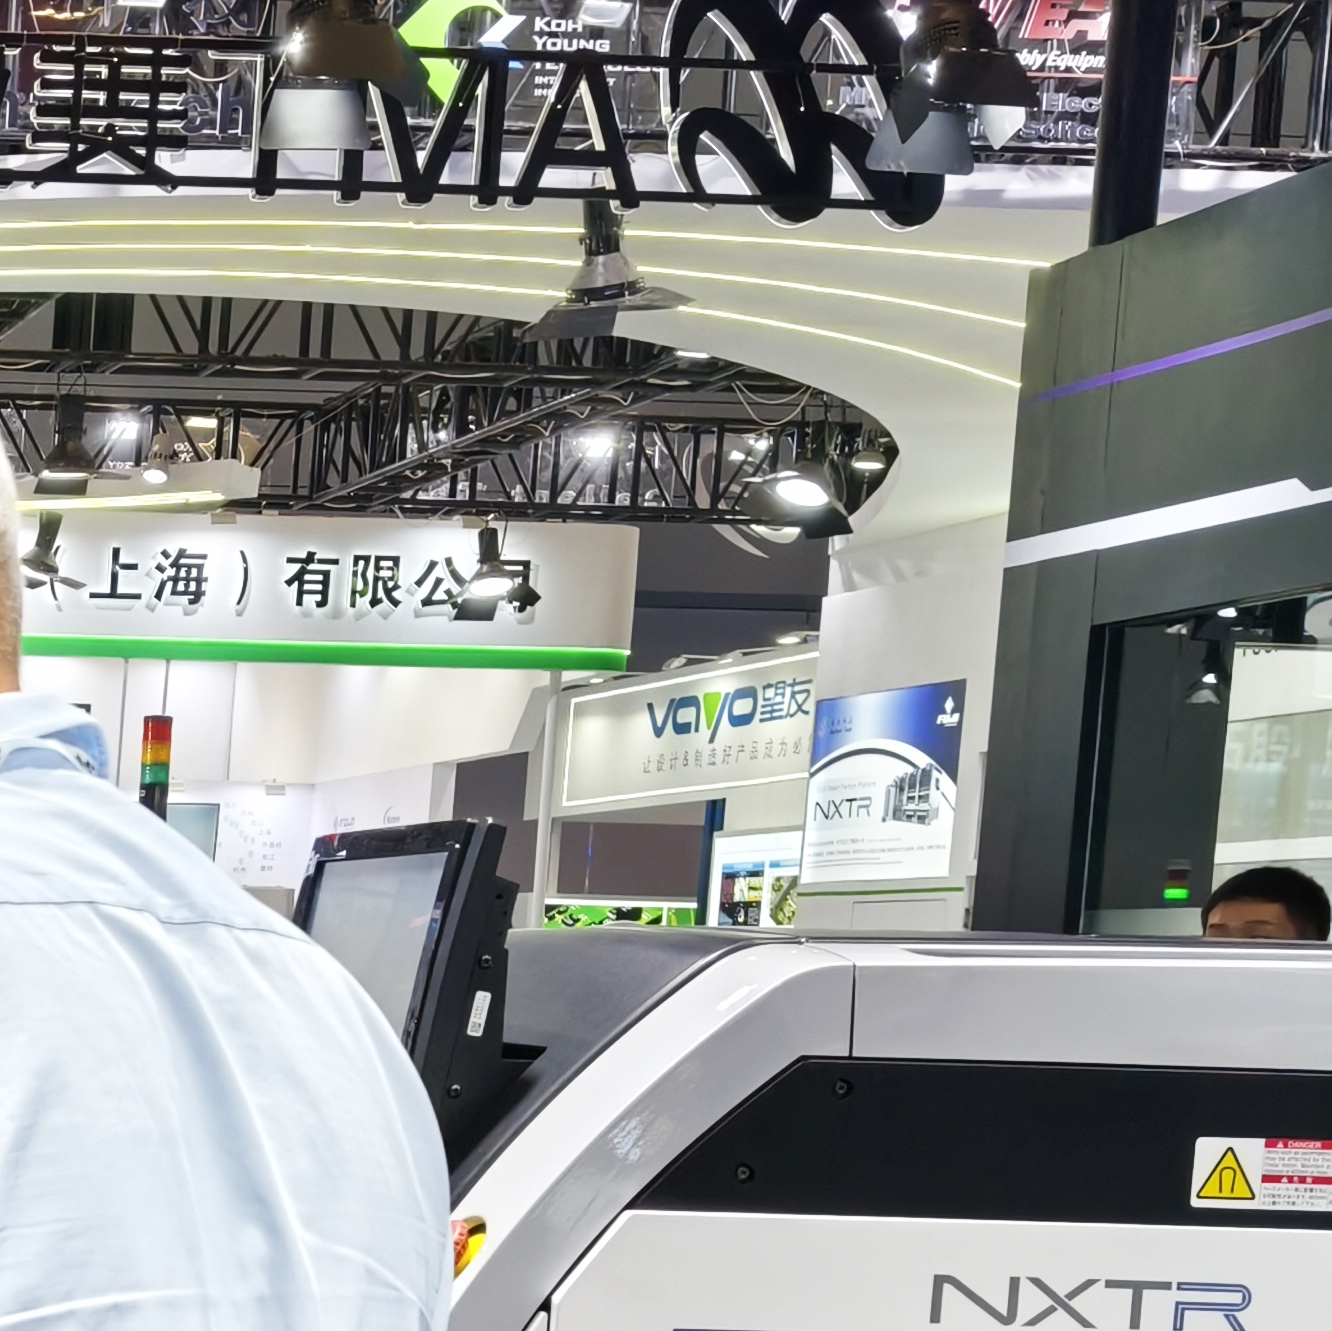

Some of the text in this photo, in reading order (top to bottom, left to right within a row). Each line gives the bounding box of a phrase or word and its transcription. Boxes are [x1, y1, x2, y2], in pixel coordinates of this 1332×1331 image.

[535, 17, 583, 32] KOH
[533, 36, 611, 52] YOUNG
[759, 677, 814, 723] 望友
[814, 796, 873, 822] NXTR
